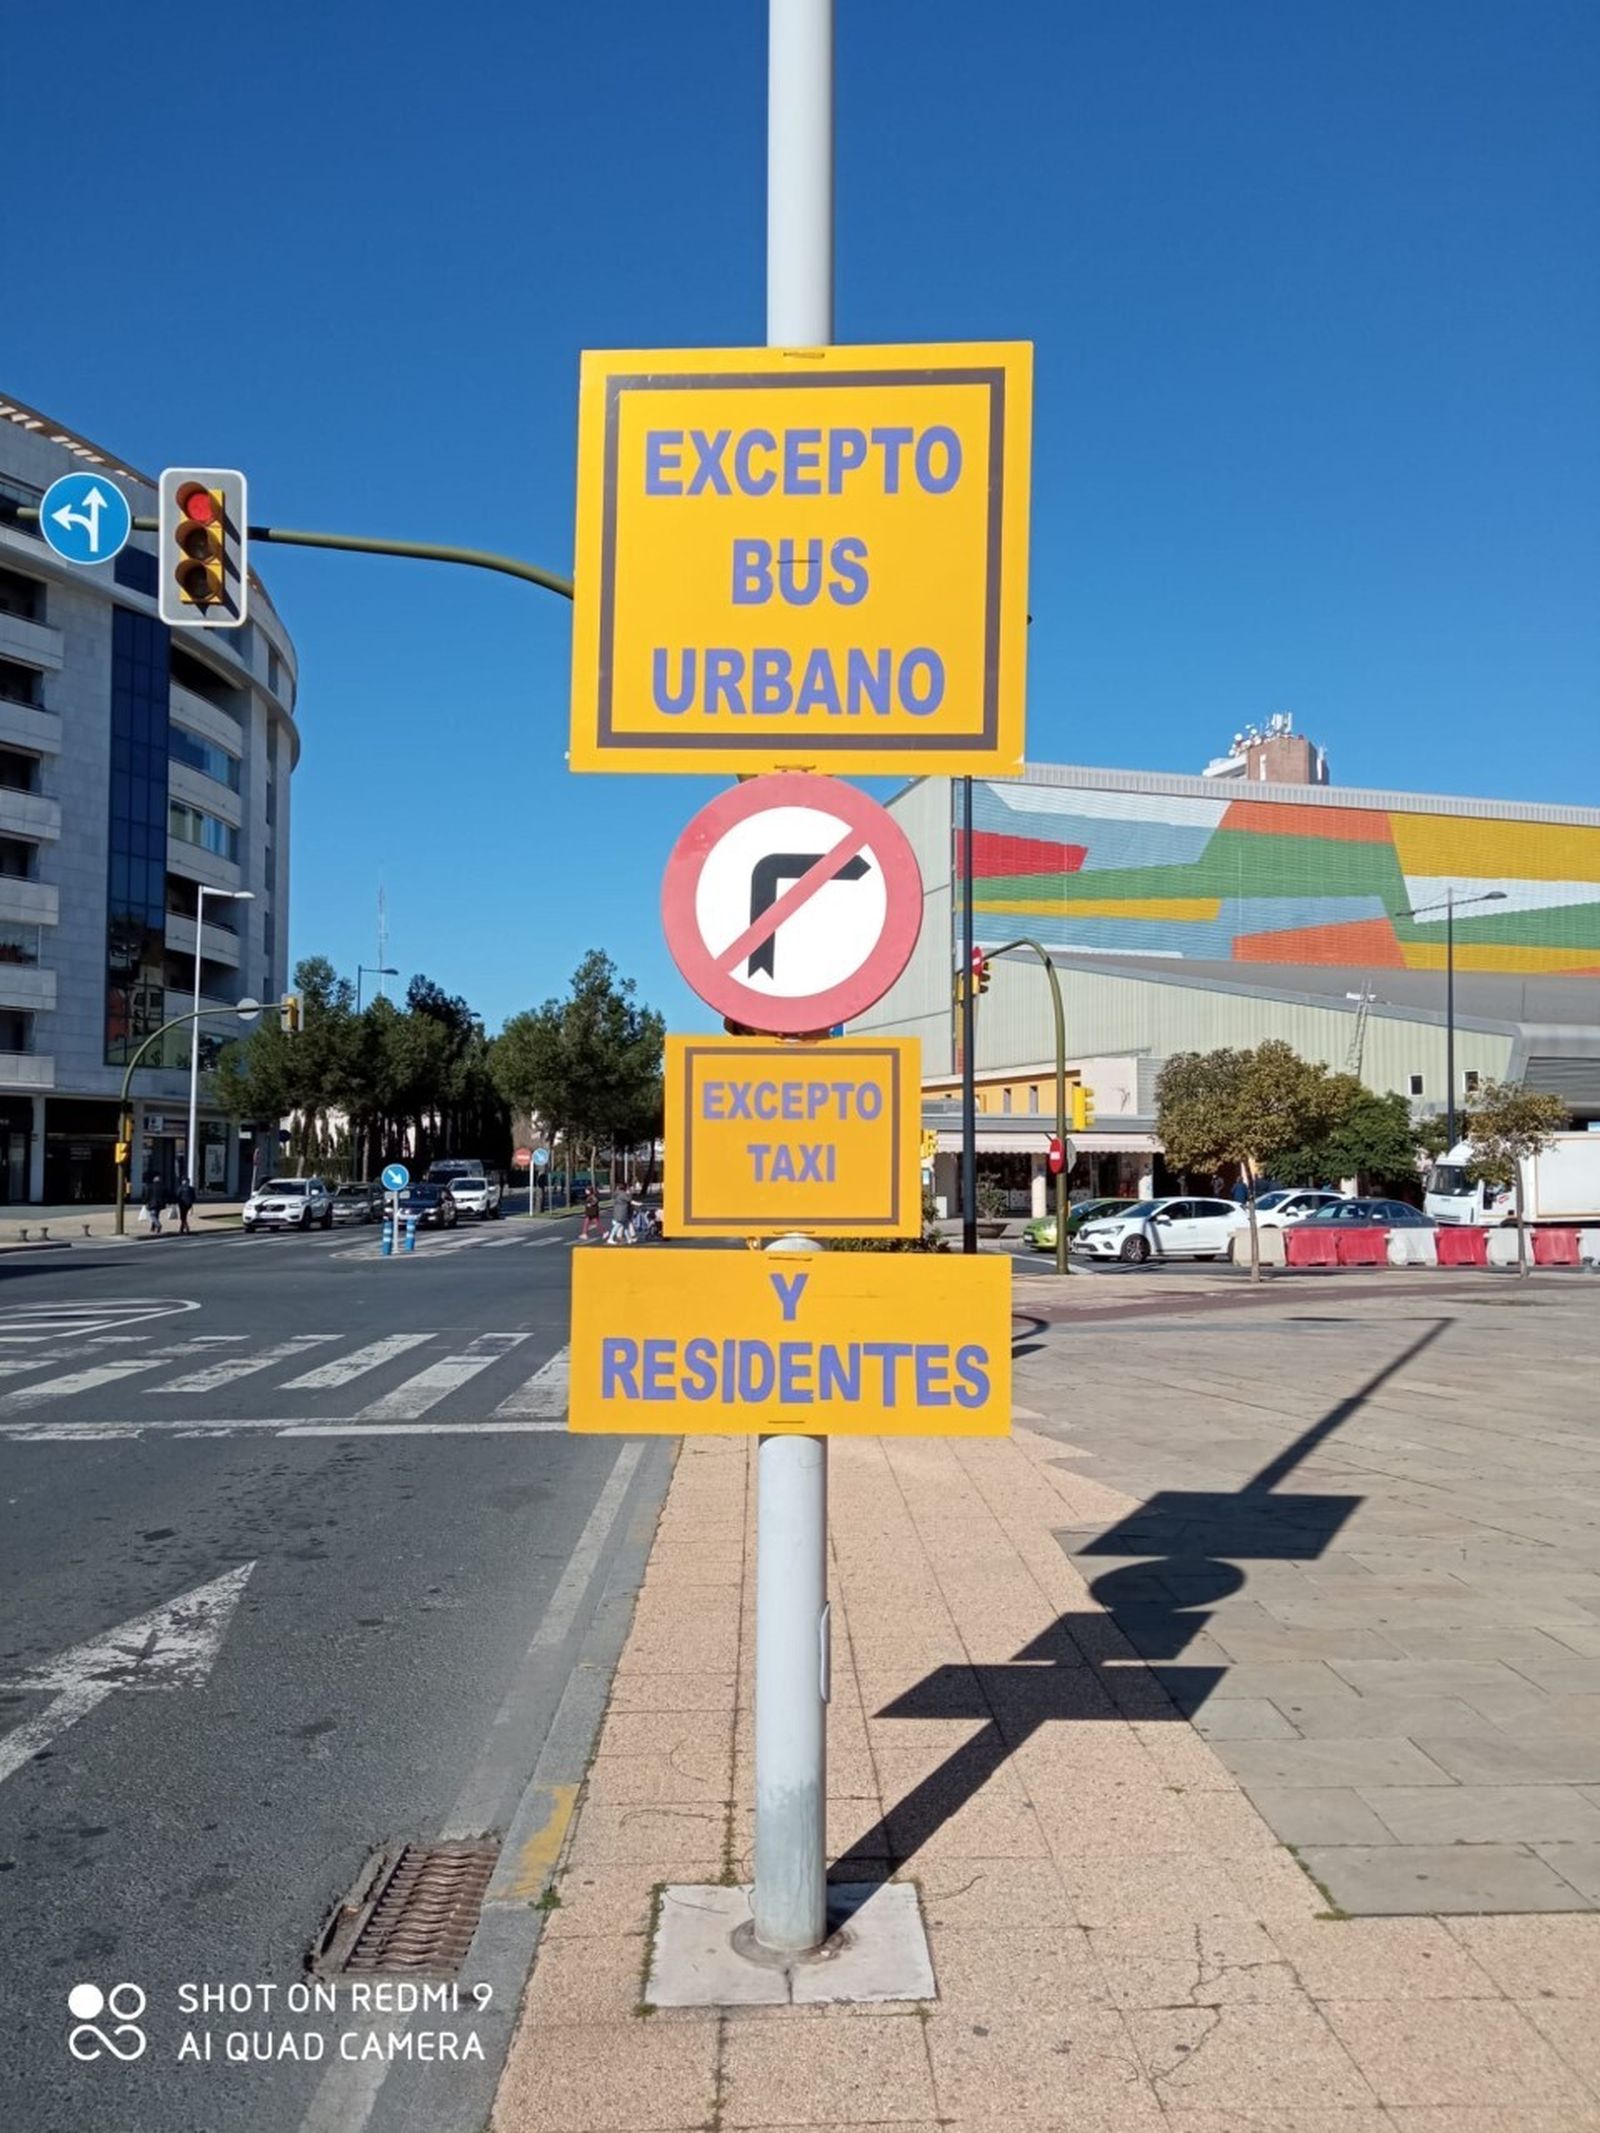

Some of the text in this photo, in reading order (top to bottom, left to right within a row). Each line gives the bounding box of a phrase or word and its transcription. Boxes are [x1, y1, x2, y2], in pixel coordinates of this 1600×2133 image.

[644, 427, 962, 496] EXCEPTO
[731, 538, 869, 606] BUS
[652, 648, 945, 716] URBANO
[702, 1081, 883, 1121] EXCEPTO
[747, 1144, 837, 1183] TAXI
[770, 1273, 809, 1321] Y
[602, 1338, 990, 1408] RESIDENTES
